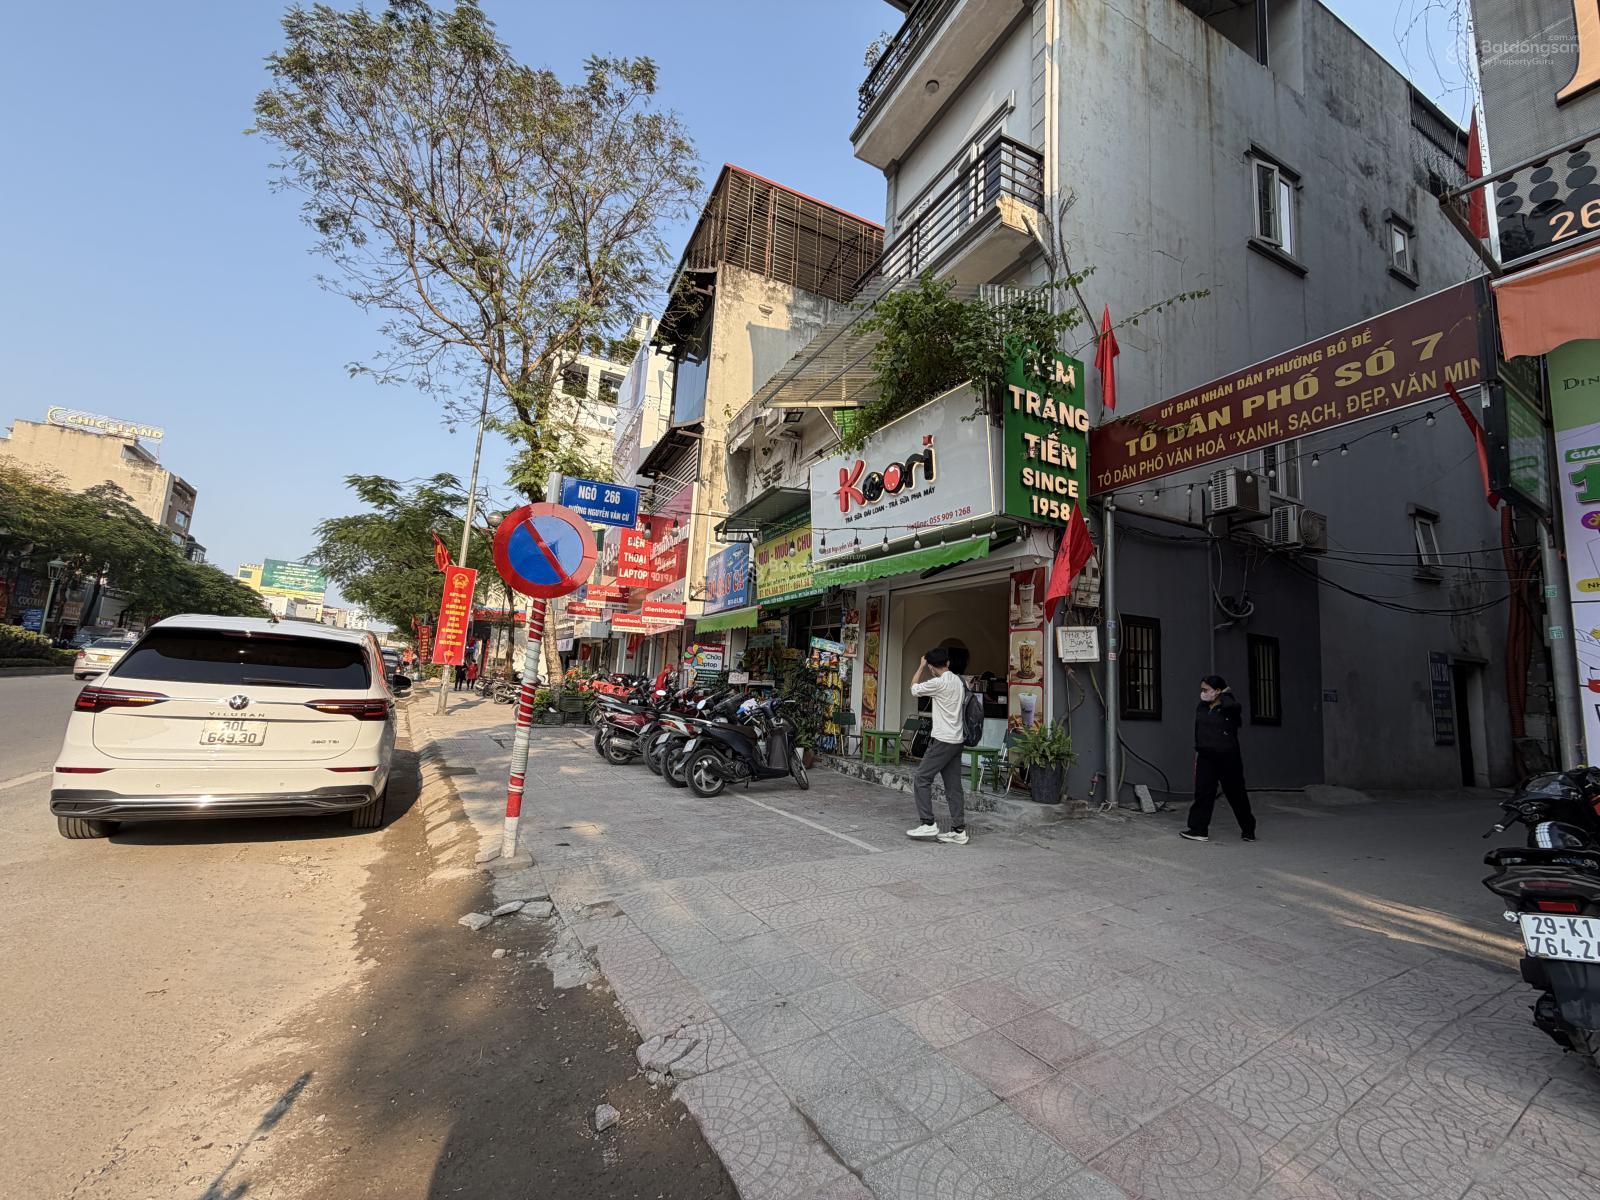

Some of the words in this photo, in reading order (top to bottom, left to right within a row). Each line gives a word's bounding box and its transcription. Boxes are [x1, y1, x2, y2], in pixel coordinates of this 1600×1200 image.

[1177, 399, 1198, 413] BAN
[1201, 382, 1232, 403] NHÂN
[1237, 371, 1262, 391] DÂN
[1267, 350, 1322, 379] PHƯỜNG
[1125, 426, 1157, 457] TỔ
[1166, 405, 1231, 444] DÂN
[1242, 367, 1320, 419] PHỐ
[1334, 338, 1395, 387] SỐ
[1412, 331, 1443, 362] 7
[1098, 468, 1111, 487] TỔ
[1114, 464, 1136, 483] DÂN
[1140, 451, 1164, 476] PHỐ
[1166, 445, 1192, 467] VĂN
[1196, 433, 1226, 458] HOÁ
[1288, 401, 1341, 431] SẠCH,
[1346, 386, 1390, 413] ĐẸP,
[1391, 370, 1437, 400] VĂN
[578, 484, 597, 501] NGÕ
[604, 489, 620, 505] 266
[1022, 467, 1079, 499] SINCE
[872, 505, 885, 515] LOAN
[888, 499, 898, 509] TRÀ
[899, 495, 909, 505] SỮA
[911, 492, 922, 502] PHA
[923, 486, 936, 497] MÁY
[1032, 495, 1070, 521] 1958
[588, 506, 609, 518] NGUYỄN
[610, 511, 620, 520] VĂN
[621, 512, 630, 522] CỪ
[929, 515, 941, 525] 055
[941, 511, 954, 521] 909
[955, 506, 971, 517] 1268
[624, 552, 647, 566] THOẠI
[619, 568, 648, 580] LAPTOP
[207, 732, 257, 744] 649.30
[1532, 916, 1594, 939] 29-K1
[1530, 936, 1600, 959] 764.2
